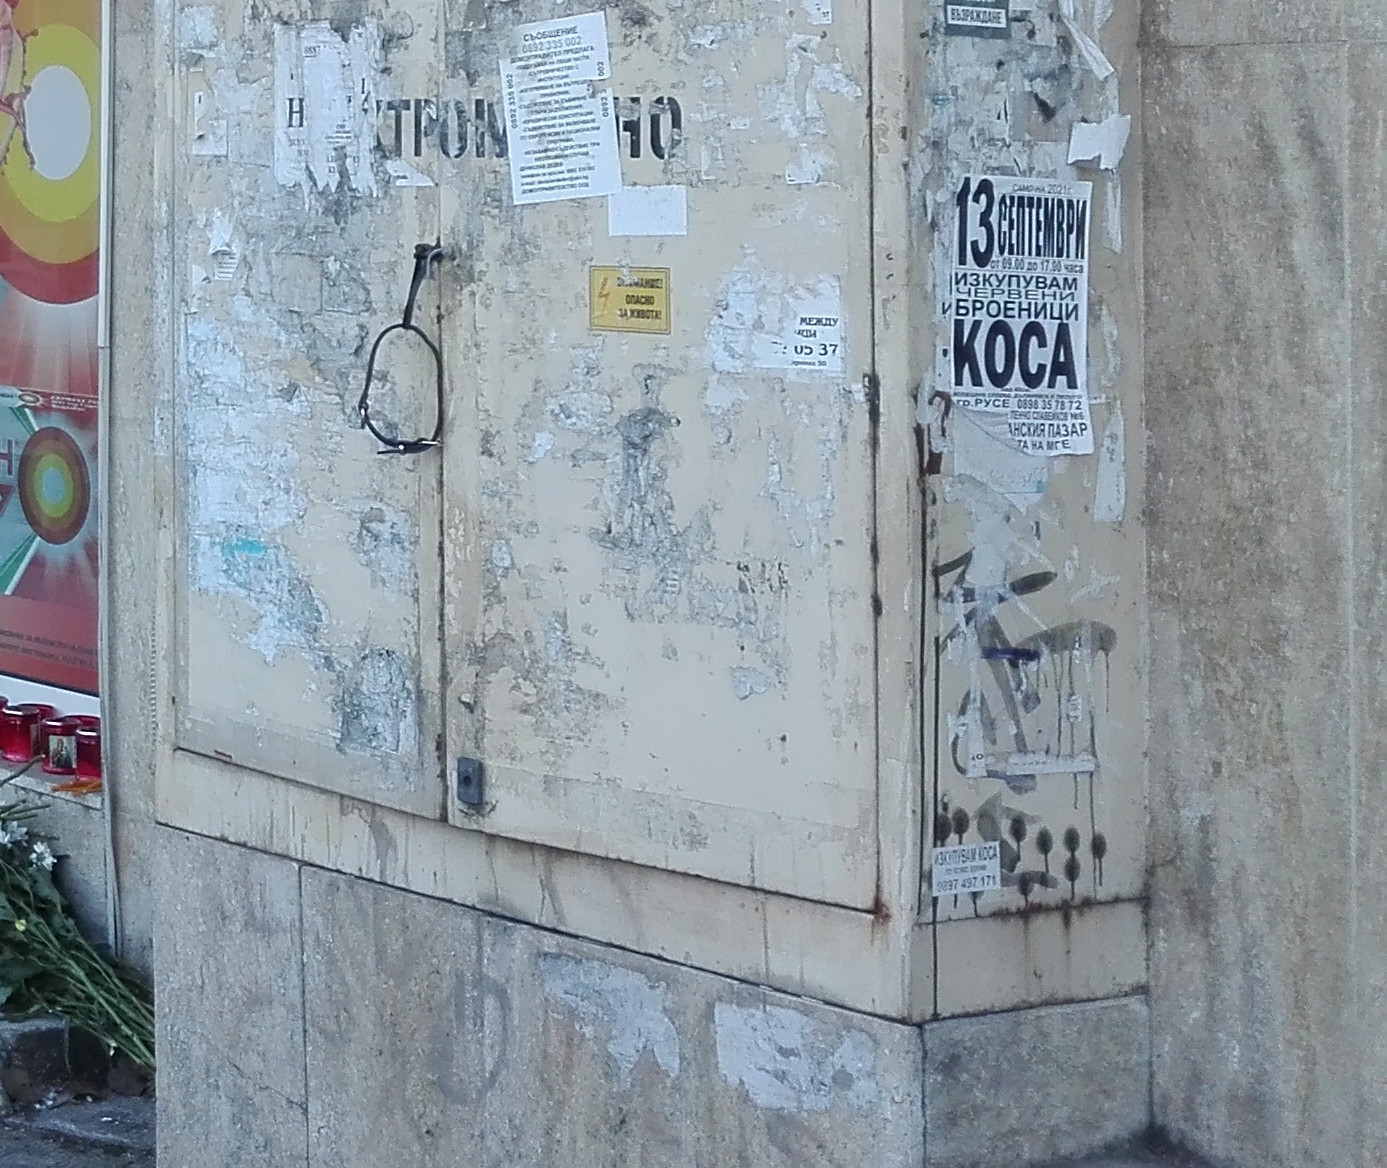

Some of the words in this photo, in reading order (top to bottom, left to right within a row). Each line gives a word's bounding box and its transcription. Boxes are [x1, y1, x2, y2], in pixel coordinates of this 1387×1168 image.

[950, 8, 1002, 24] ВЪЗРАЖДАНЕ
[523, 25, 579, 42] СЪОБЩЕНИЕ
[956, 176, 995, 269] 13
[997, 193, 1087, 260] СЕПТЕМВРИ
[954, 272, 1078, 291] ИЗКУПУВАМ
[625, 294, 655, 306] ОПАСНО
[955, 287, 1076, 301] ЧЕРВЕНИ
[954, 298, 1079, 321] БРОЕНИЦИ
[799, 317, 839, 328] МЕЖДУ
[819, 343, 839, 356] 37
[953, 318, 1079, 390] КОСА
[1047, 422, 1088, 438] ПАЗАР
